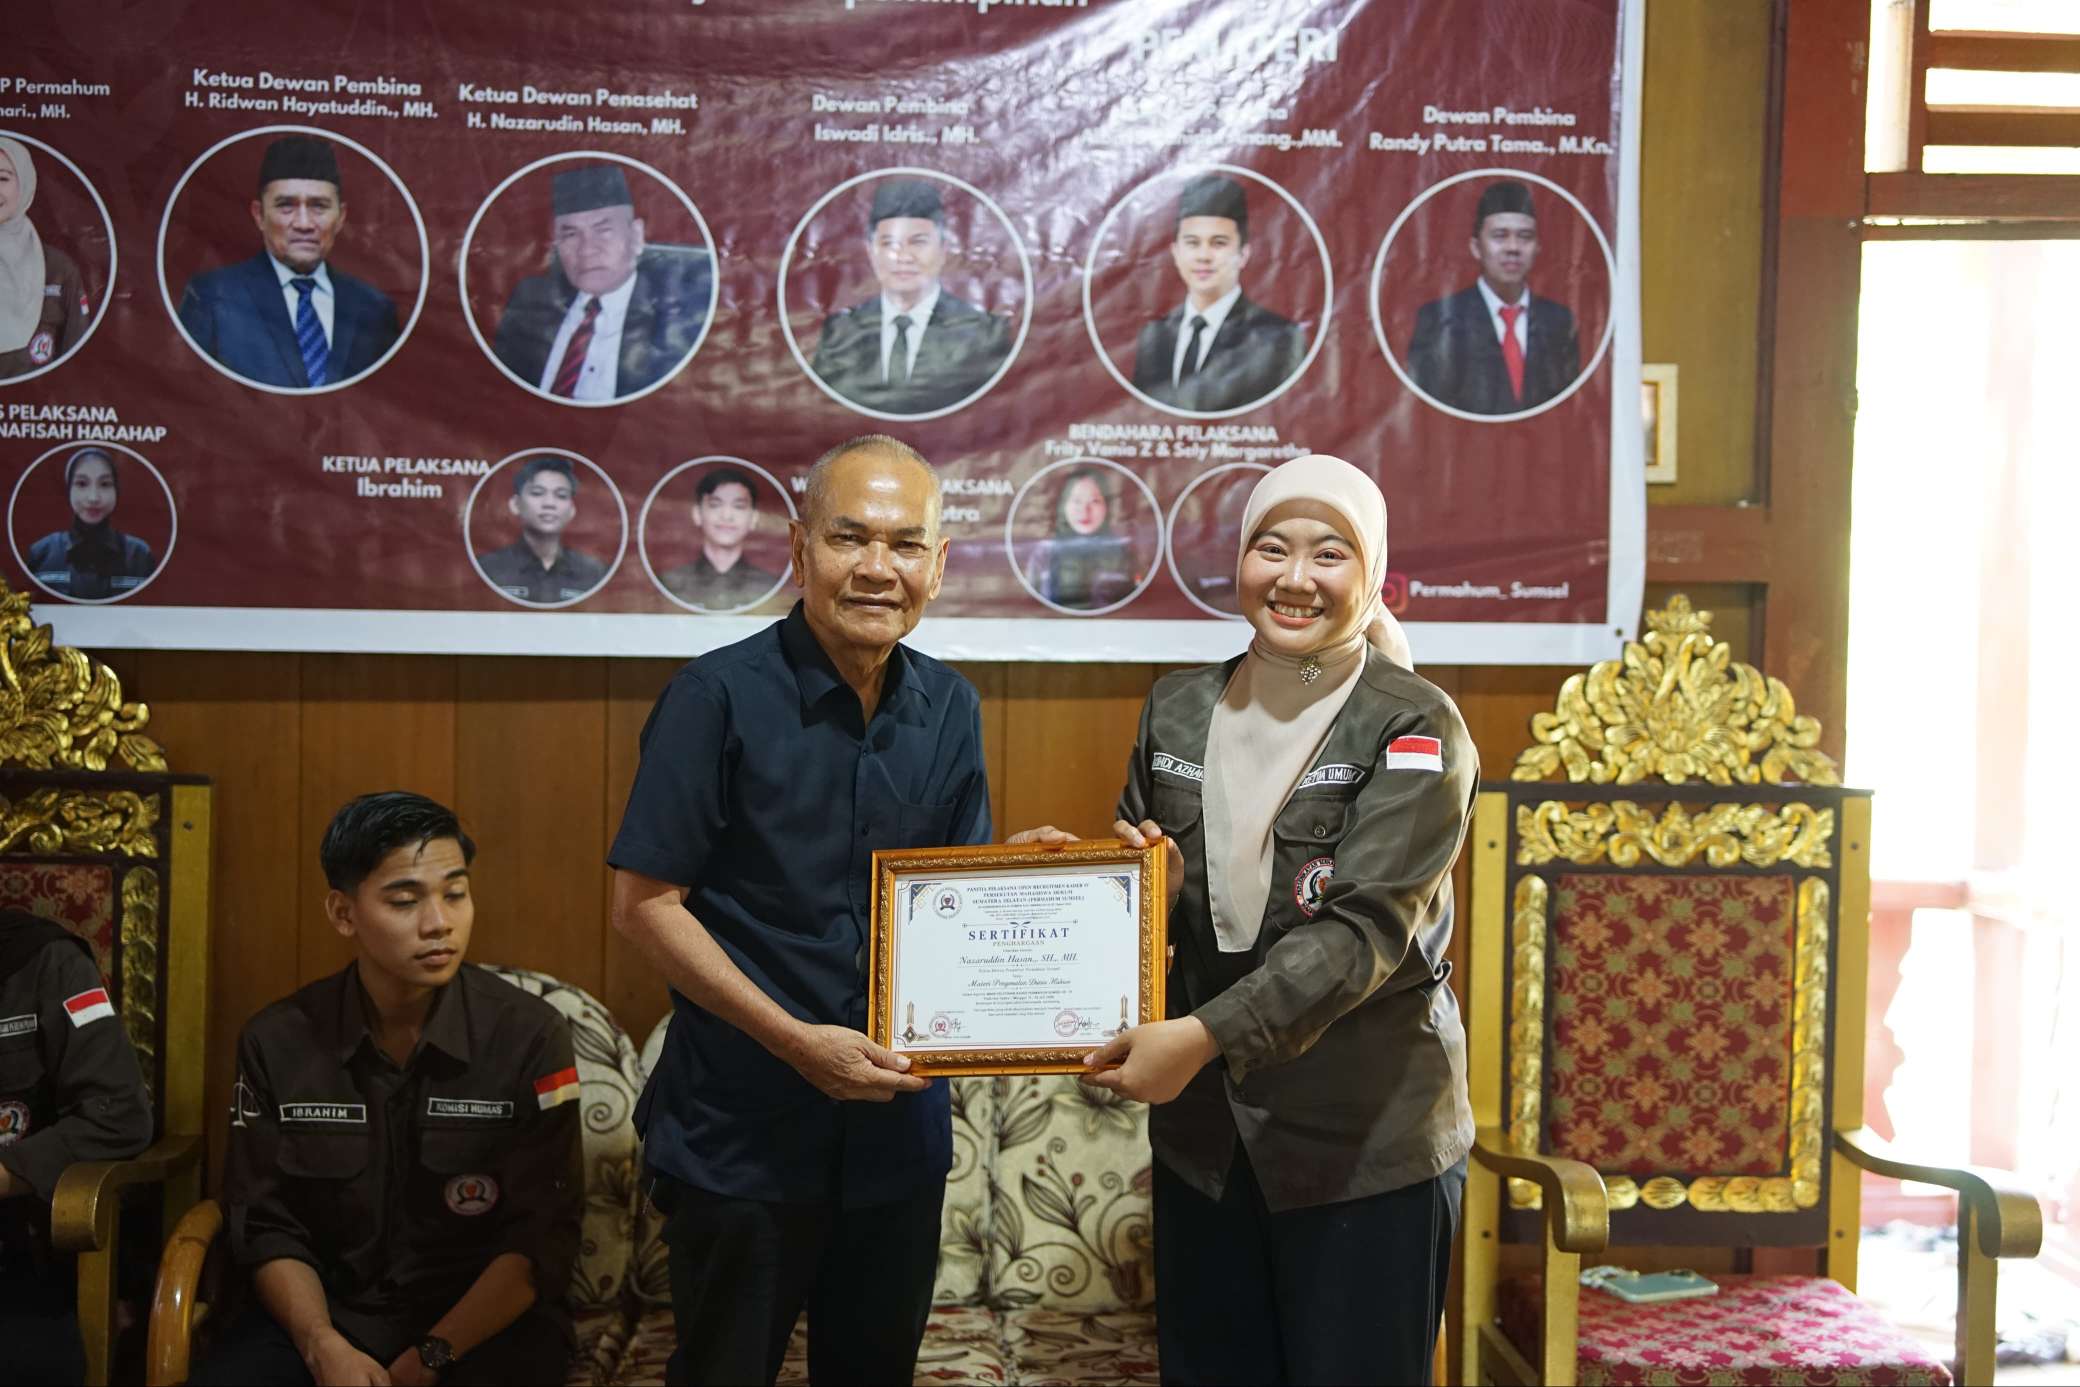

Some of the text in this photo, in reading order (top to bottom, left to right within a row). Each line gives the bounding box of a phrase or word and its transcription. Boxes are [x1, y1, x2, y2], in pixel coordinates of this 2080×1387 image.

[15, 77, 111, 96] Permahum
[193, 68, 421, 96] Ketua Dewan Pembina
[185, 91, 438, 118] H. Ridwan Hayatuddin., MH.
[458, 83, 698, 110] Ketua Dewan Penasehat
[812, 94, 969, 114] Dewan Pembina
[40, 104, 71, 118] MH.
[1423, 105, 1576, 126] Dewan Pembina
[467, 112, 687, 136] H. Nazarudin Hasan, MH.
[814, 123, 879, 142] Iswadi
[941, 126, 980, 144] MH.
[1369, 132, 1430, 155] Randy
[1433, 133, 1487, 151] Putra
[1559, 136, 1613, 154] M.Kn.
[9, 404, 118, 423] PELAKSANA
[77, 424, 167, 442] HARAHAP
[1068, 424, 1279, 443] BENDAHARA PELAKSANA
[1139, 441, 1153, 457] Z
[1155, 441, 1170, 457] &
[322, 455, 491, 476] KETUA PELAKSANA
[357, 477, 443, 498] Ibrahim
[942, 478, 1014, 496] AKSANA
[968, 927, 1070, 941] SERTIFIKAT
[293, 1107, 348, 1119] IBRAHIM
